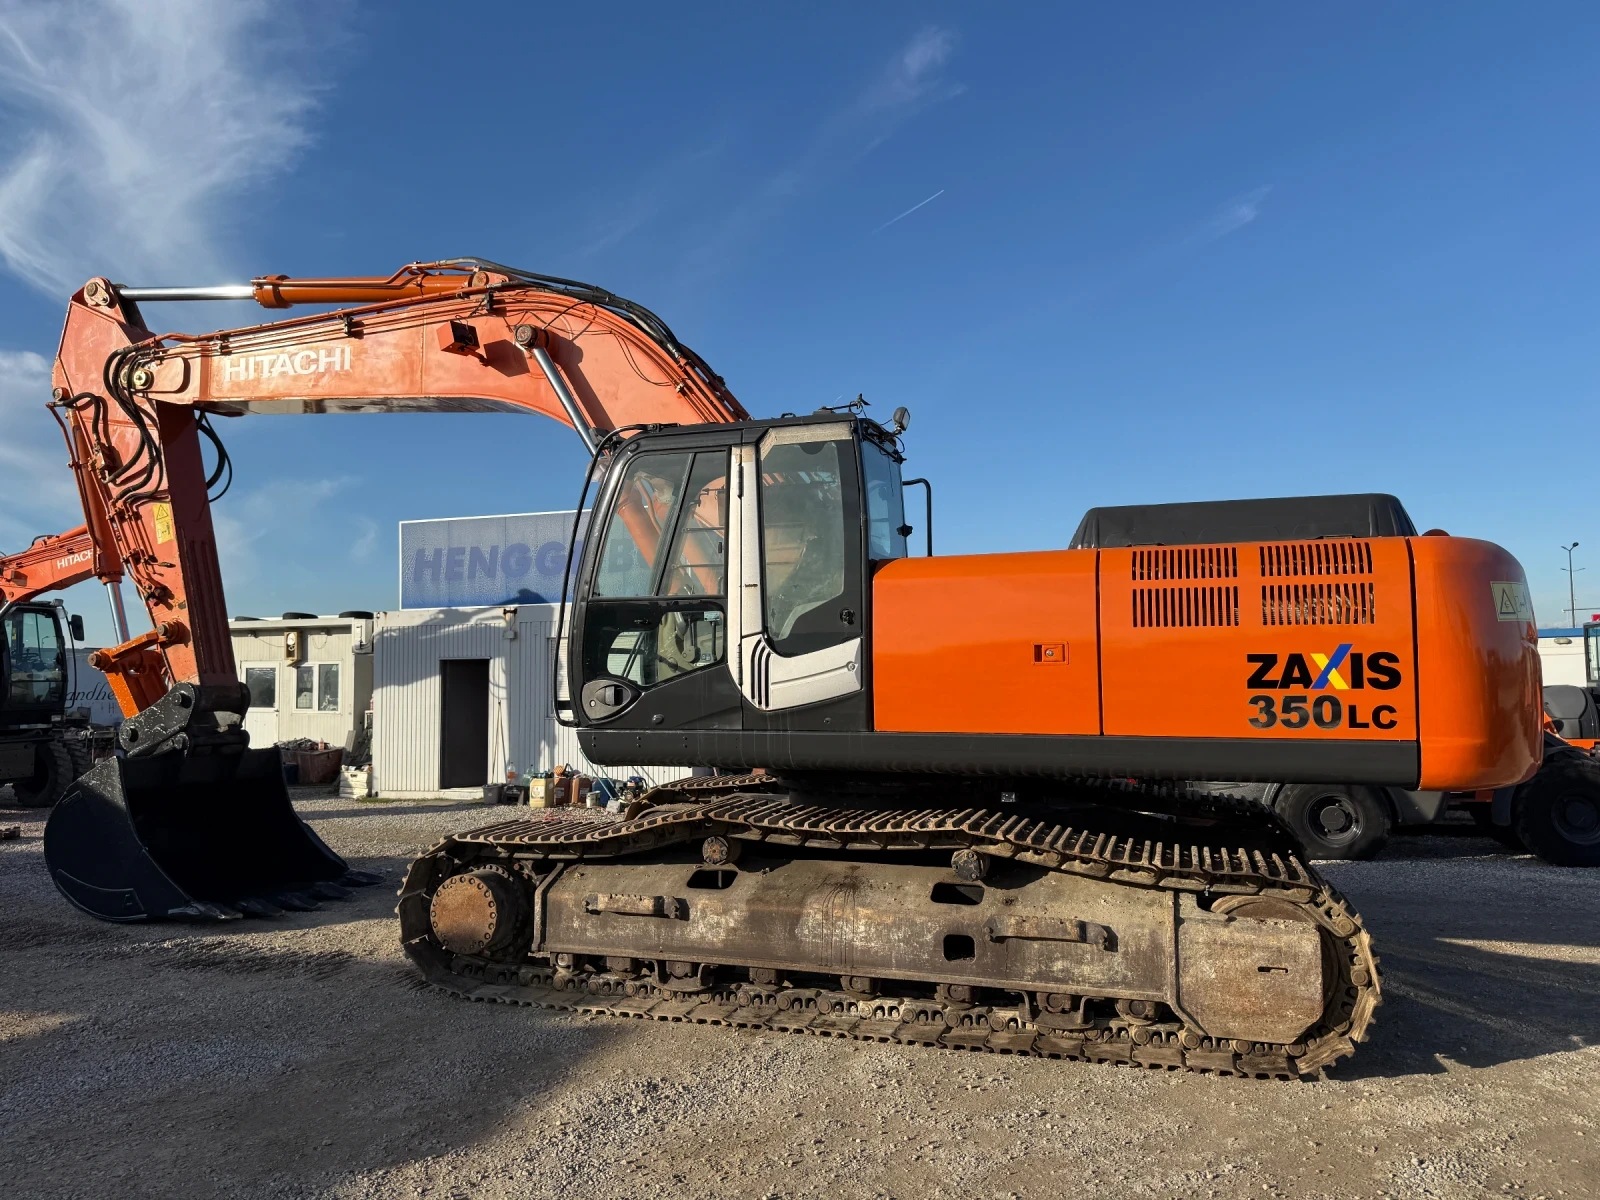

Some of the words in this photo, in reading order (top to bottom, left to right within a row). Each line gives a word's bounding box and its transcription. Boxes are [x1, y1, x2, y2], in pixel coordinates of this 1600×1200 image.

[224, 345, 351, 382] HITACHI
[57, 549, 94, 569] HITACH
[1247, 643, 1402, 690] ZAXIS
[66, 681, 117, 701] andhe
